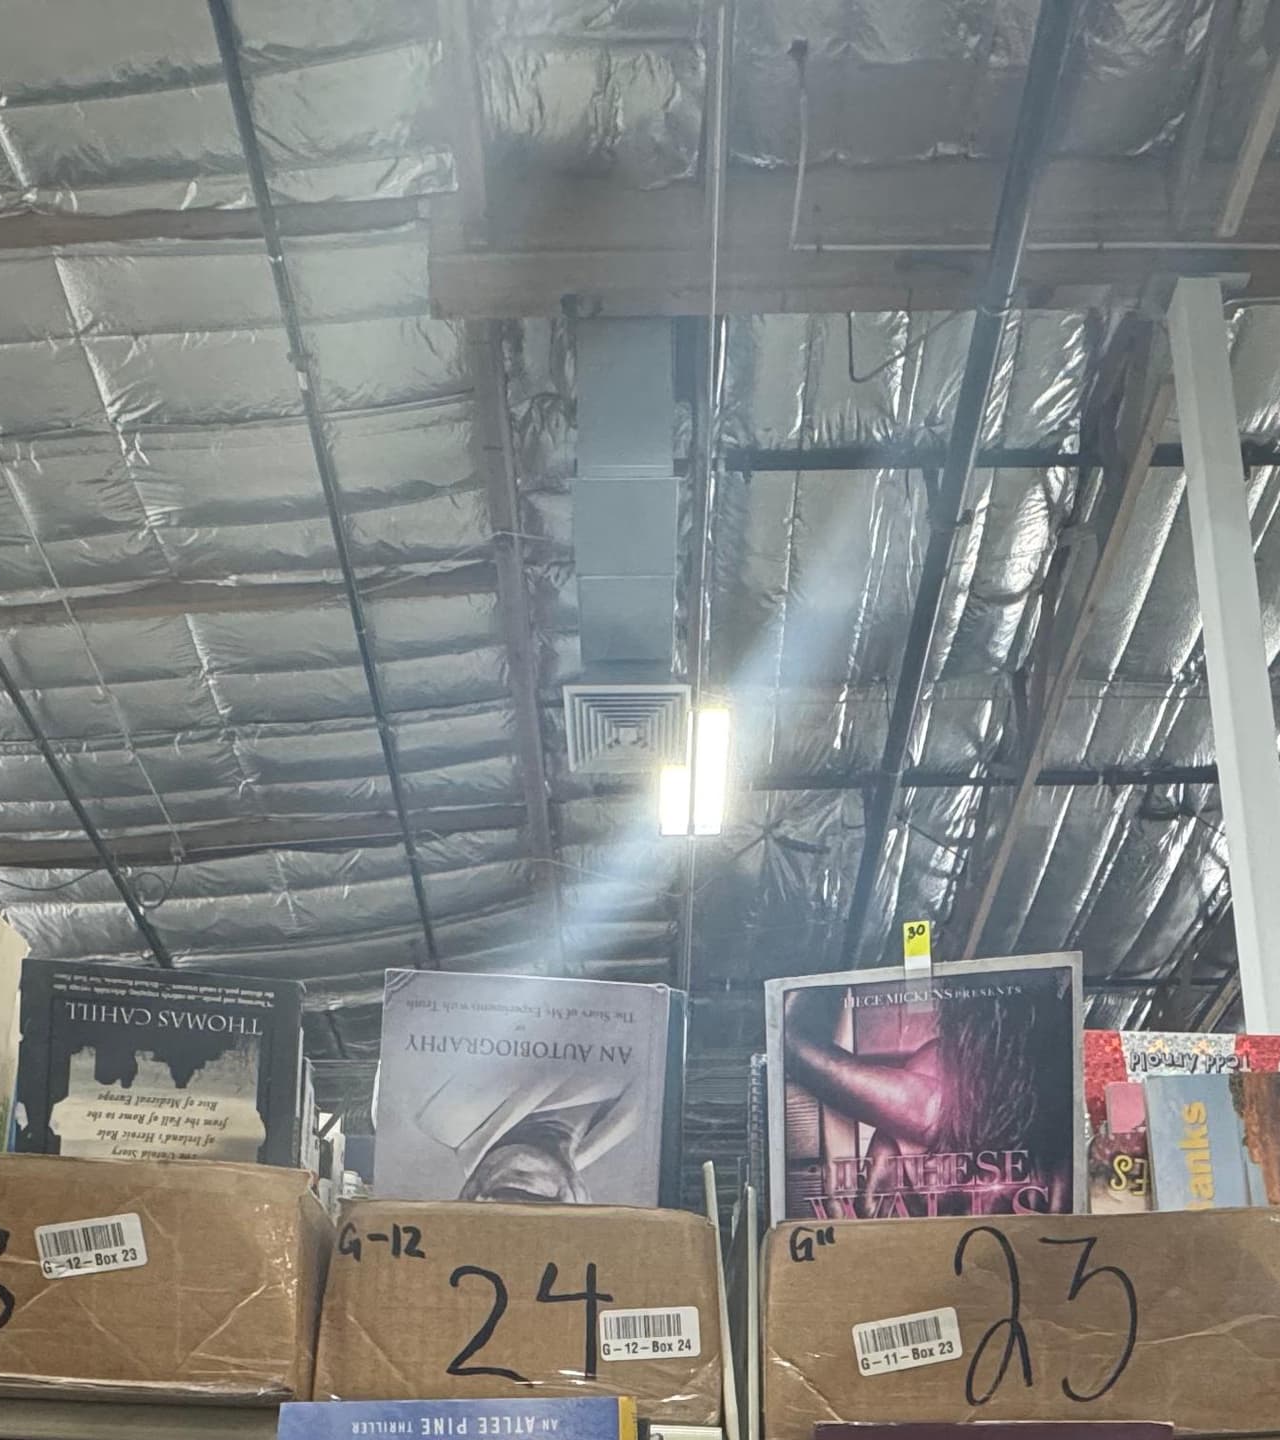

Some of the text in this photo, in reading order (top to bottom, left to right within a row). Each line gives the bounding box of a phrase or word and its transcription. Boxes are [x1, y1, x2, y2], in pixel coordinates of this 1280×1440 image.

[887, 985, 1022, 1006] MICKENS PRESENTS
[65, 1001, 264, 1036] THOMAS CAHILL
[582, 1008, 634, 1023] The Story
[405, 1033, 633, 1066] AN AUTOBIOGRAPHY
[1129, 1051, 1199, 1074] Arnold
[97, 1091, 181, 1109] Medieval Europe
[86, 1111, 229, 1129] from the Fall of Rome to the
[96, 1130, 156, 1143] Heroic Role
[887, 1150, 1035, 1191] THESE
[339, 1222, 426, 1262] G-12
[120, 1247, 138, 1264] 23
[446, 1261, 614, 1388] 24
[953, 1225, 1138, 1407] 23
[676, 1339, 692, 1353] 24
[938, 1340, 955, 1355] 23
[351, 1416, 558, 1435] AN ATLEE PINE THRILLER
